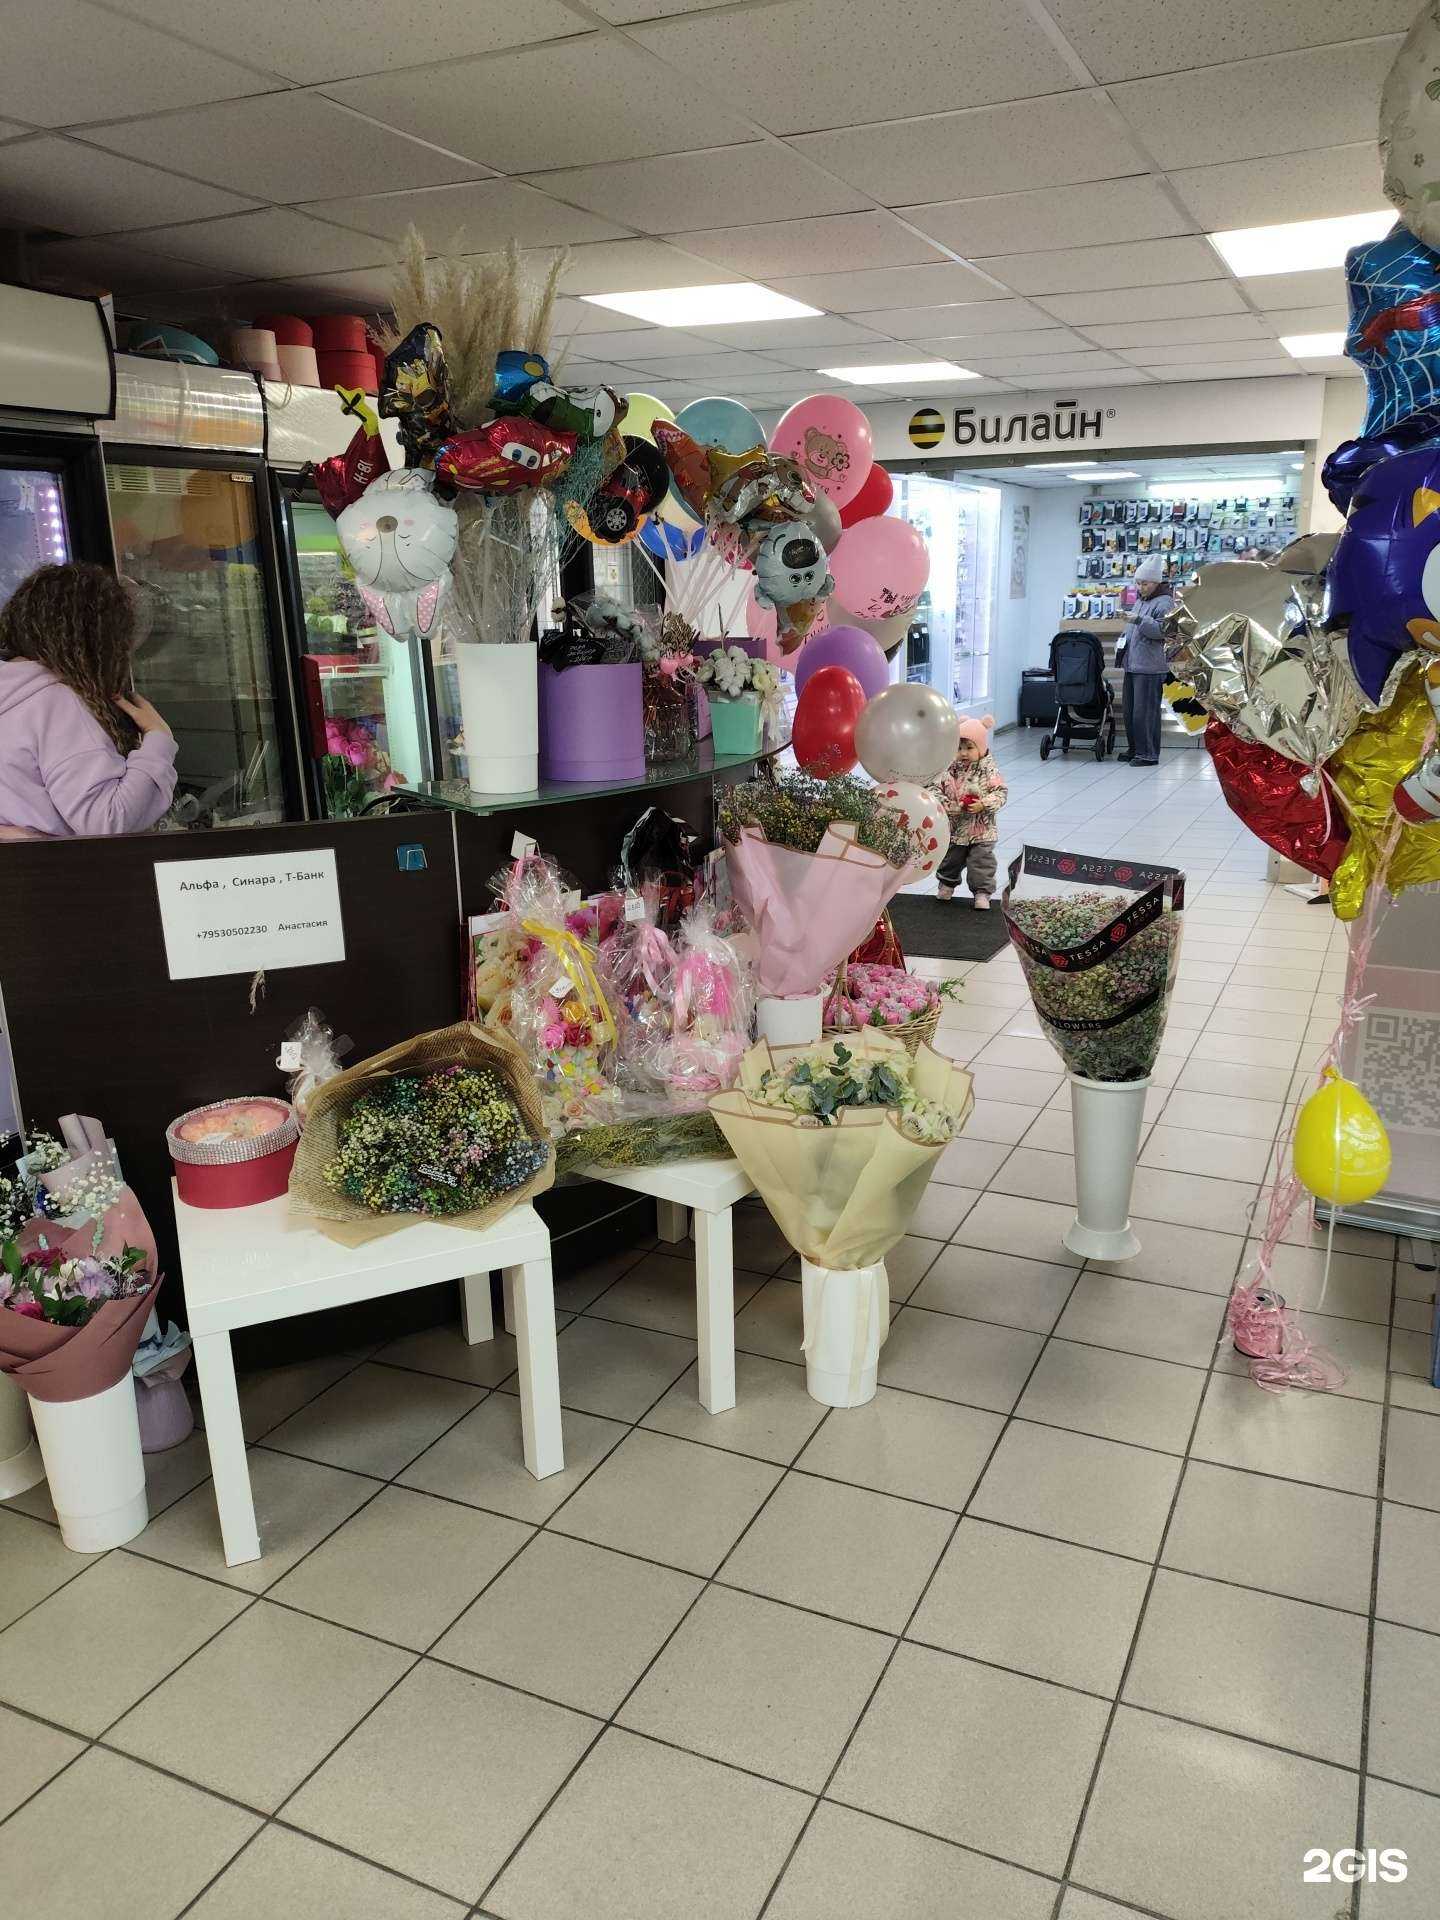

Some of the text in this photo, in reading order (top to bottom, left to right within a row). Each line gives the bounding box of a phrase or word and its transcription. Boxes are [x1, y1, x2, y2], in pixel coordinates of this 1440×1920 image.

[179, 880, 219, 891] Альфа
[232, 875, 276, 887] Синара
[285, 871, 325, 882] Т-Банк
[197, 920, 328, 939] +79530502230 Анастасия
[1070, 940, 1106, 961] TESSA
[1127, 897, 1160, 924] TESSA
